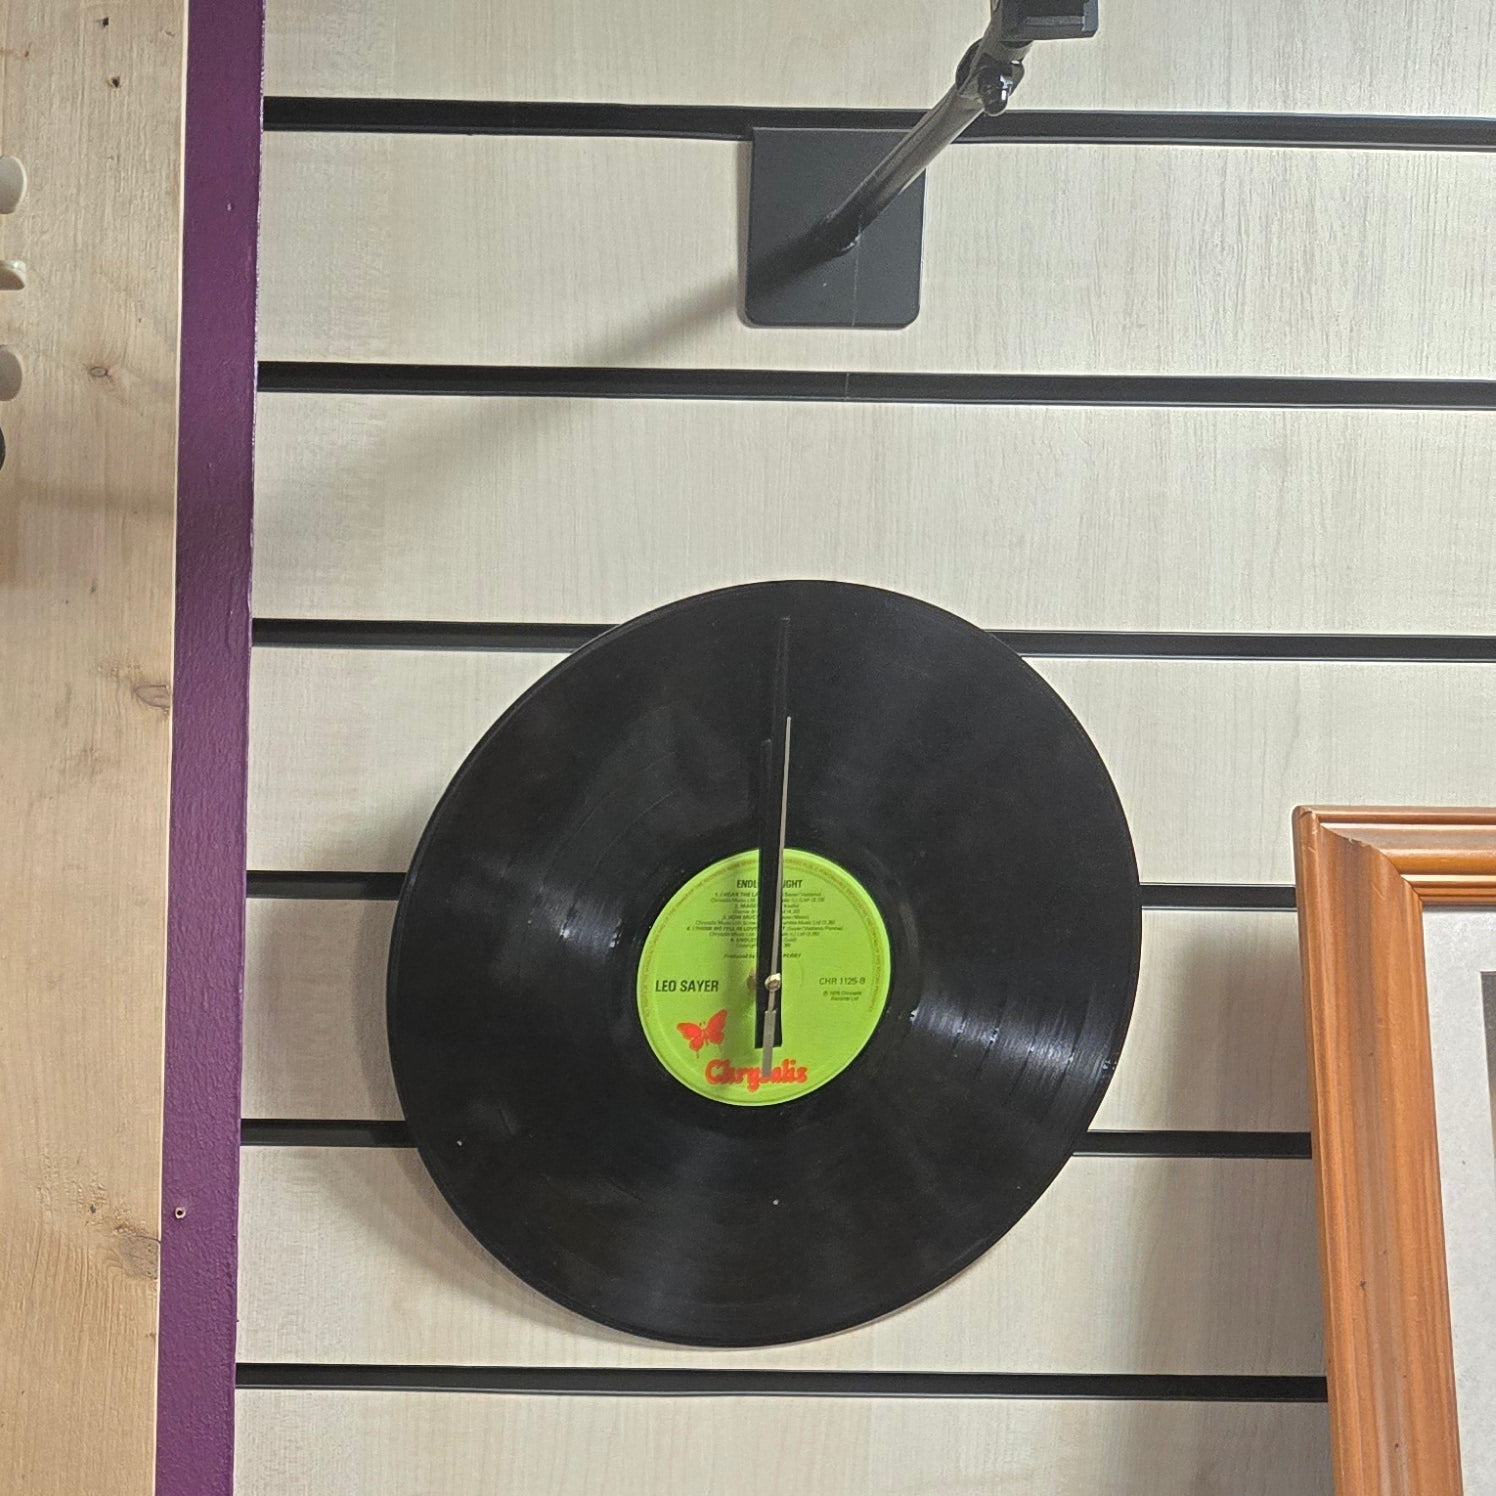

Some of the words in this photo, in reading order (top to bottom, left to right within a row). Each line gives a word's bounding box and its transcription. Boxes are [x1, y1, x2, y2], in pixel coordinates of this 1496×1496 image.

[655, 980, 676, 993] LEO
[680, 980, 719, 993] SAYER
[819, 977, 837, 985] CHR
[705, 1058, 807, 1092] Chryalis
